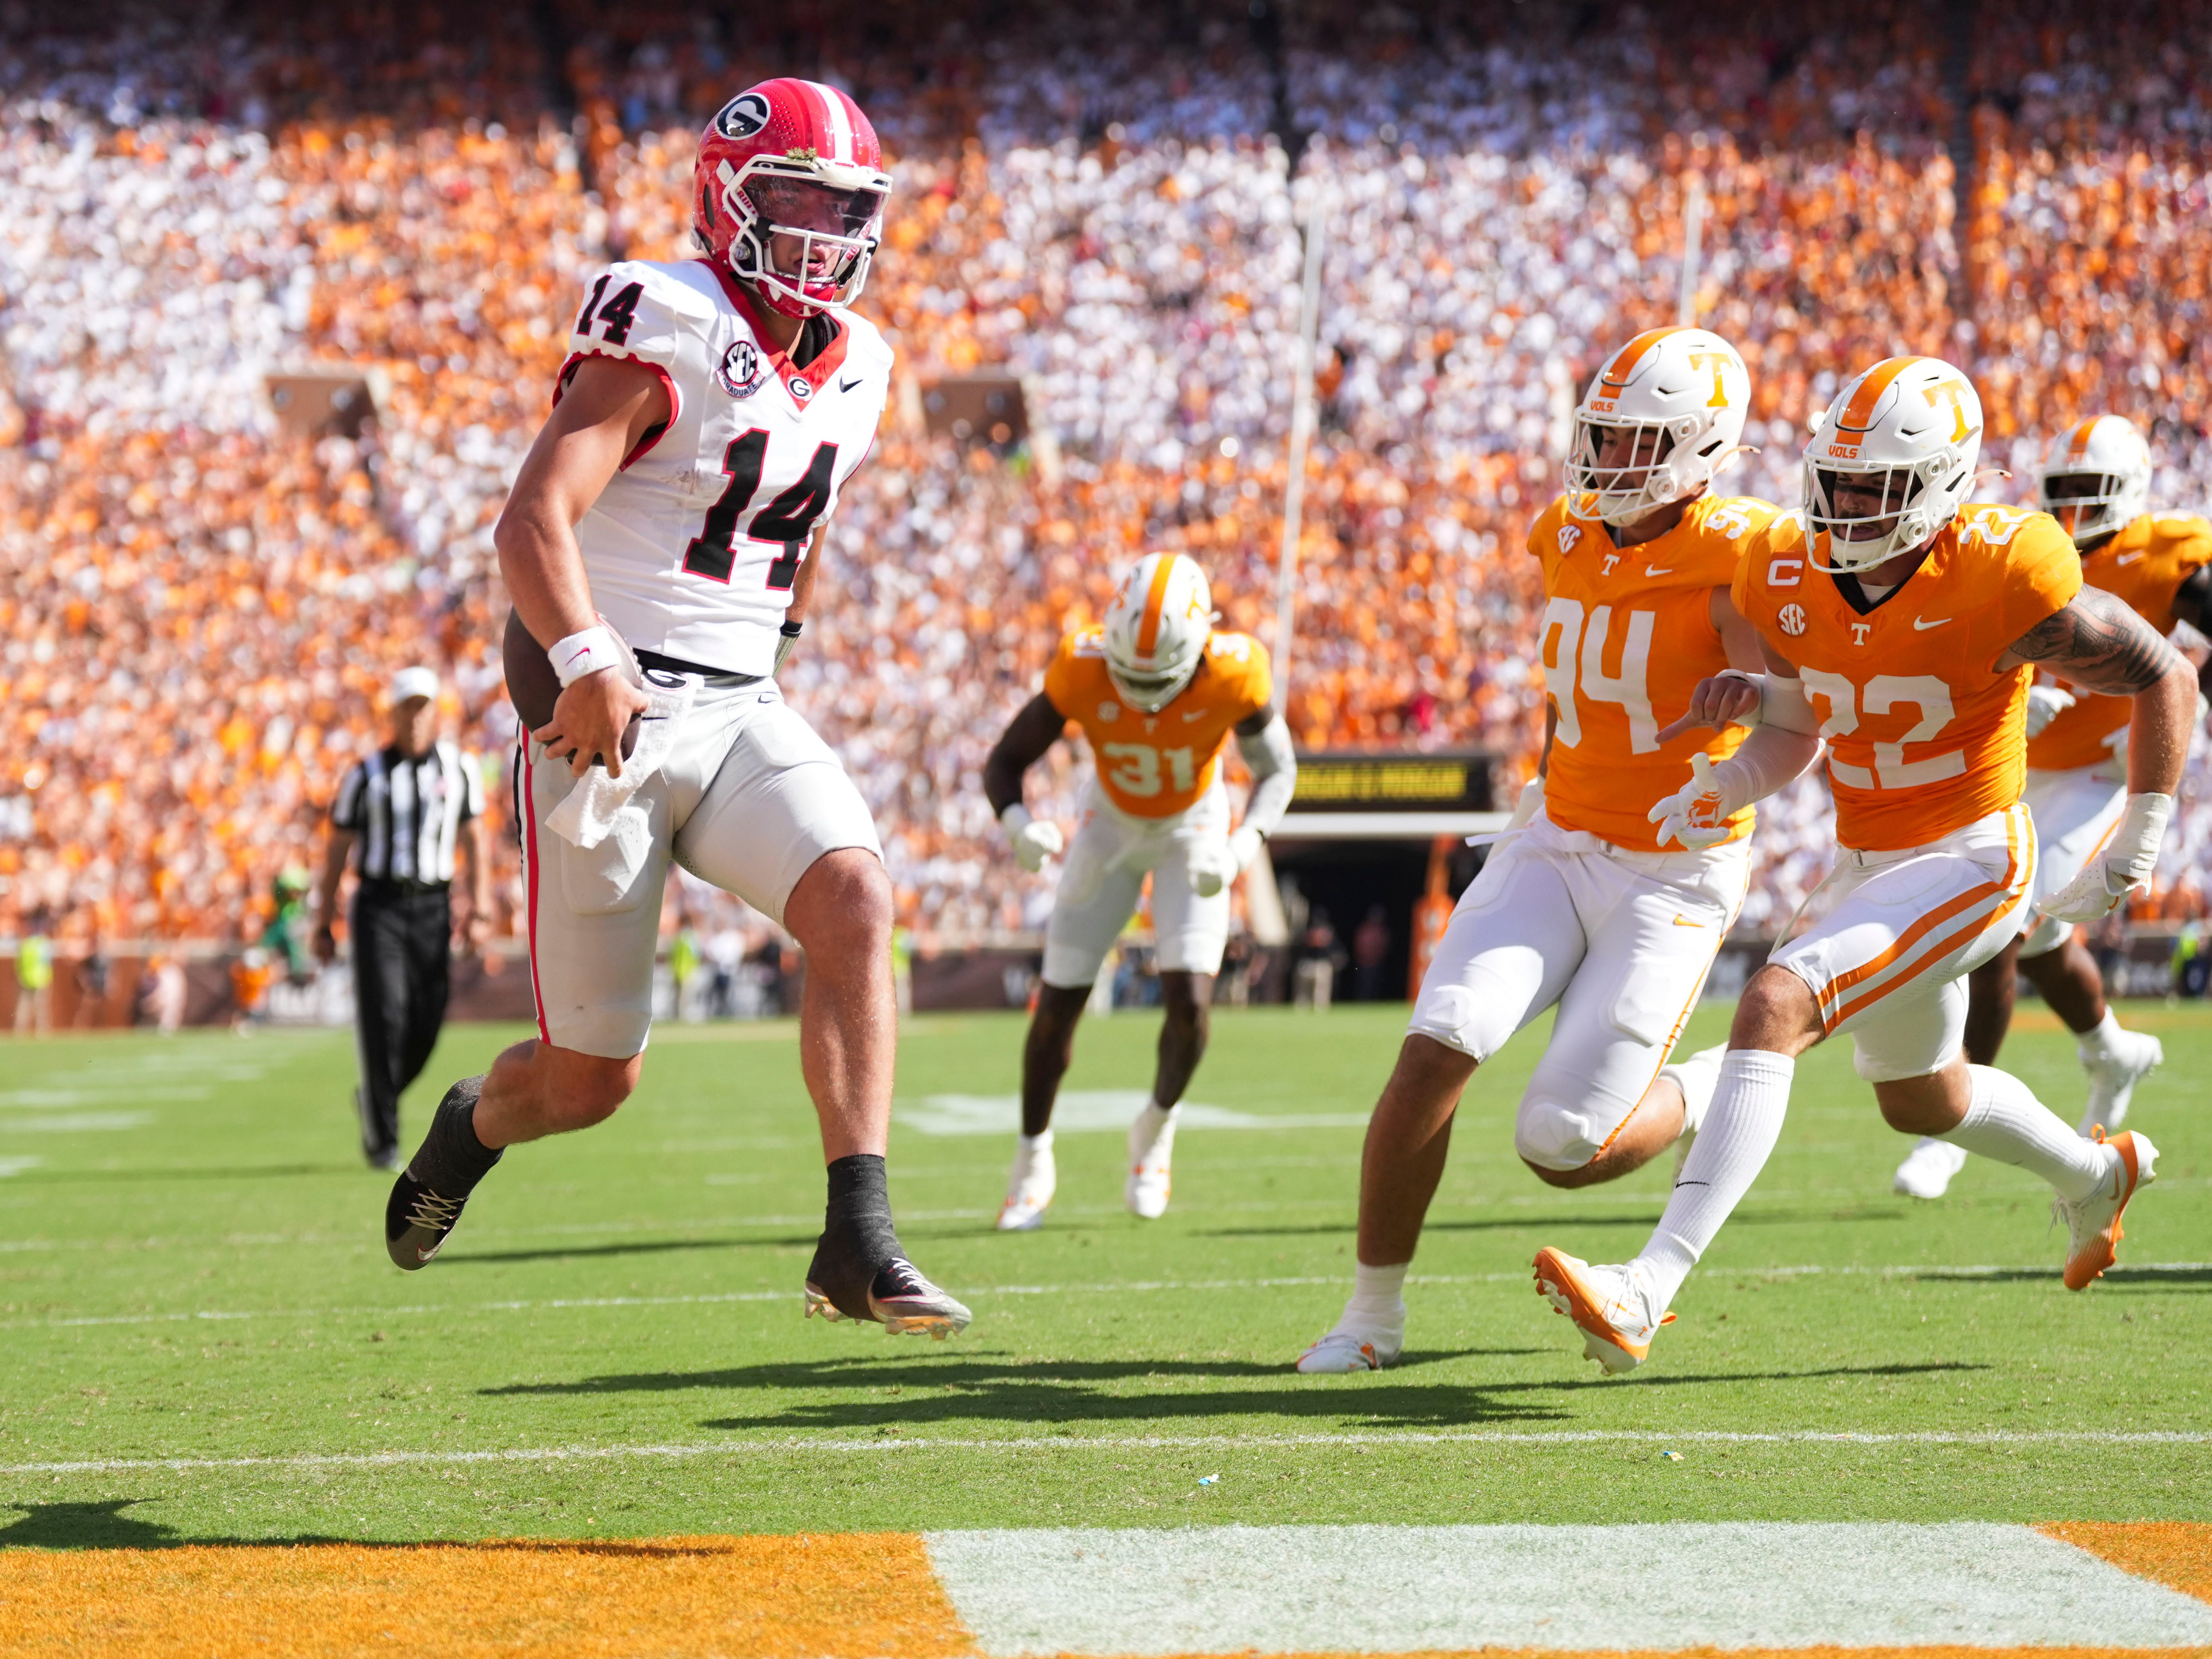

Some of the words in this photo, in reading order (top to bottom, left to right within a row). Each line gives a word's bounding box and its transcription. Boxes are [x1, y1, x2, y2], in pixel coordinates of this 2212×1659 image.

[717, 95, 767, 137] G
[576, 274, 645, 347] 14
[726, 343, 756, 382] SEC
[1689, 353, 1732, 407] T
[722, 377, 758, 397] GRADUATE
[789, 378, 811, 397] G
[1590, 400, 1615, 412] VOLS
[1921, 379, 1971, 443] T
[1828, 445, 1858, 459] VOLS
[681, 428, 839, 591] 14
[1601, 554, 1621, 576] T
[1767, 560, 1803, 586] C
[1779, 603, 1805, 636] SEC
[1851, 623, 1871, 646] T
[1536, 596, 1661, 755] 94
[1799, 665, 1967, 790] 22
[1102, 742, 1194, 797] 31
